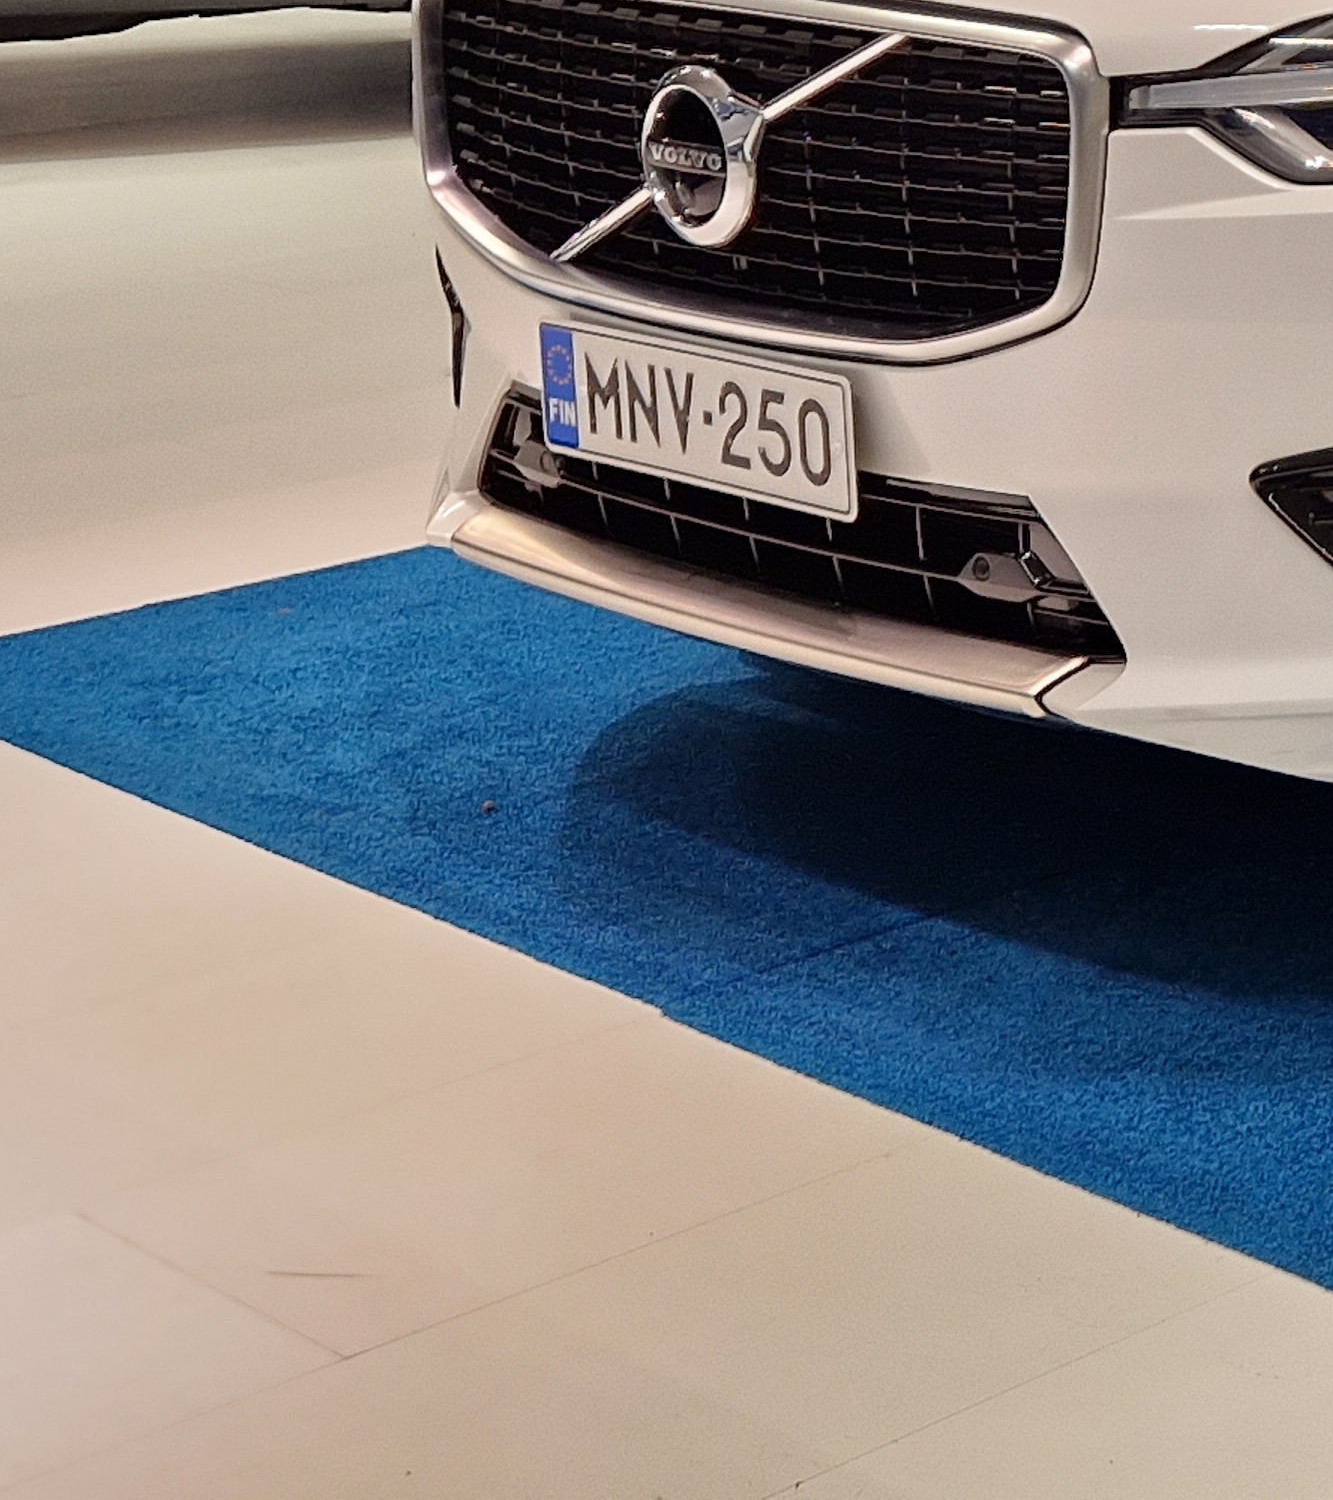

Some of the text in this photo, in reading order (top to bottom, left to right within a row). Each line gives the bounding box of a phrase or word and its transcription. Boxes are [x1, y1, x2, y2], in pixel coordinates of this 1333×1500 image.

[648, 141, 722, 171] VOLVO
[549, 396, 577, 428] FIN
[584, 351, 832, 487] MNV-250
